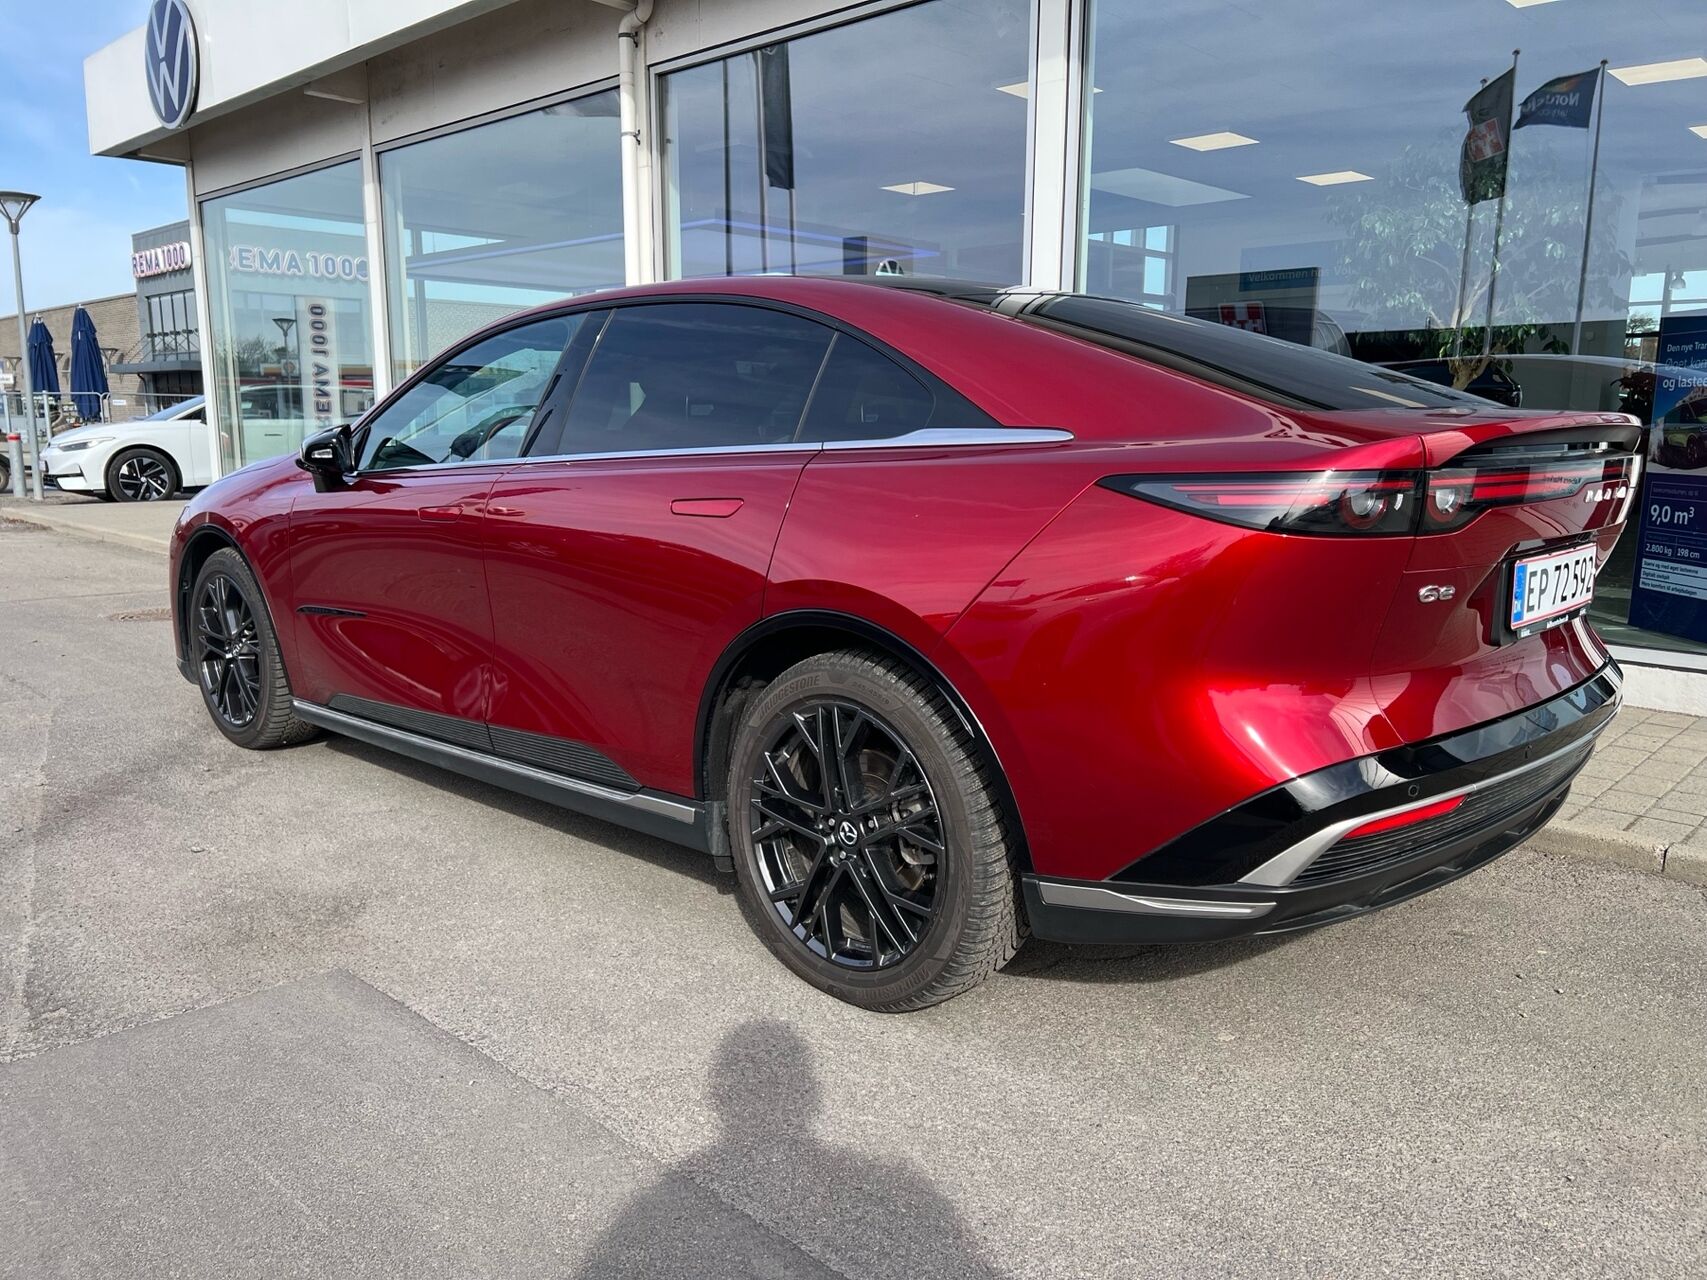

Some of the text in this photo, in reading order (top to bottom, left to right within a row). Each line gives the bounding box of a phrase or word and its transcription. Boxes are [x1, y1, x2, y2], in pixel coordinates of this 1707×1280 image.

[146, 0, 193, 128] VW
[132, 243, 186, 275] REMA 1000
[229, 246, 369, 281] EMA 1000
[1248, 267, 1308, 282] Velkommen
[1667, 343, 1681, 352] Den
[1681, 343, 1693, 354] nye
[1662, 380, 1675, 392] og
[1650, 504, 1671, 526] 9,0
[1645, 543, 1672, 556] 2.800 kg
[1676, 547, 1700, 559] 198 cm
[1526, 555, 1594, 613] EP 72 592
